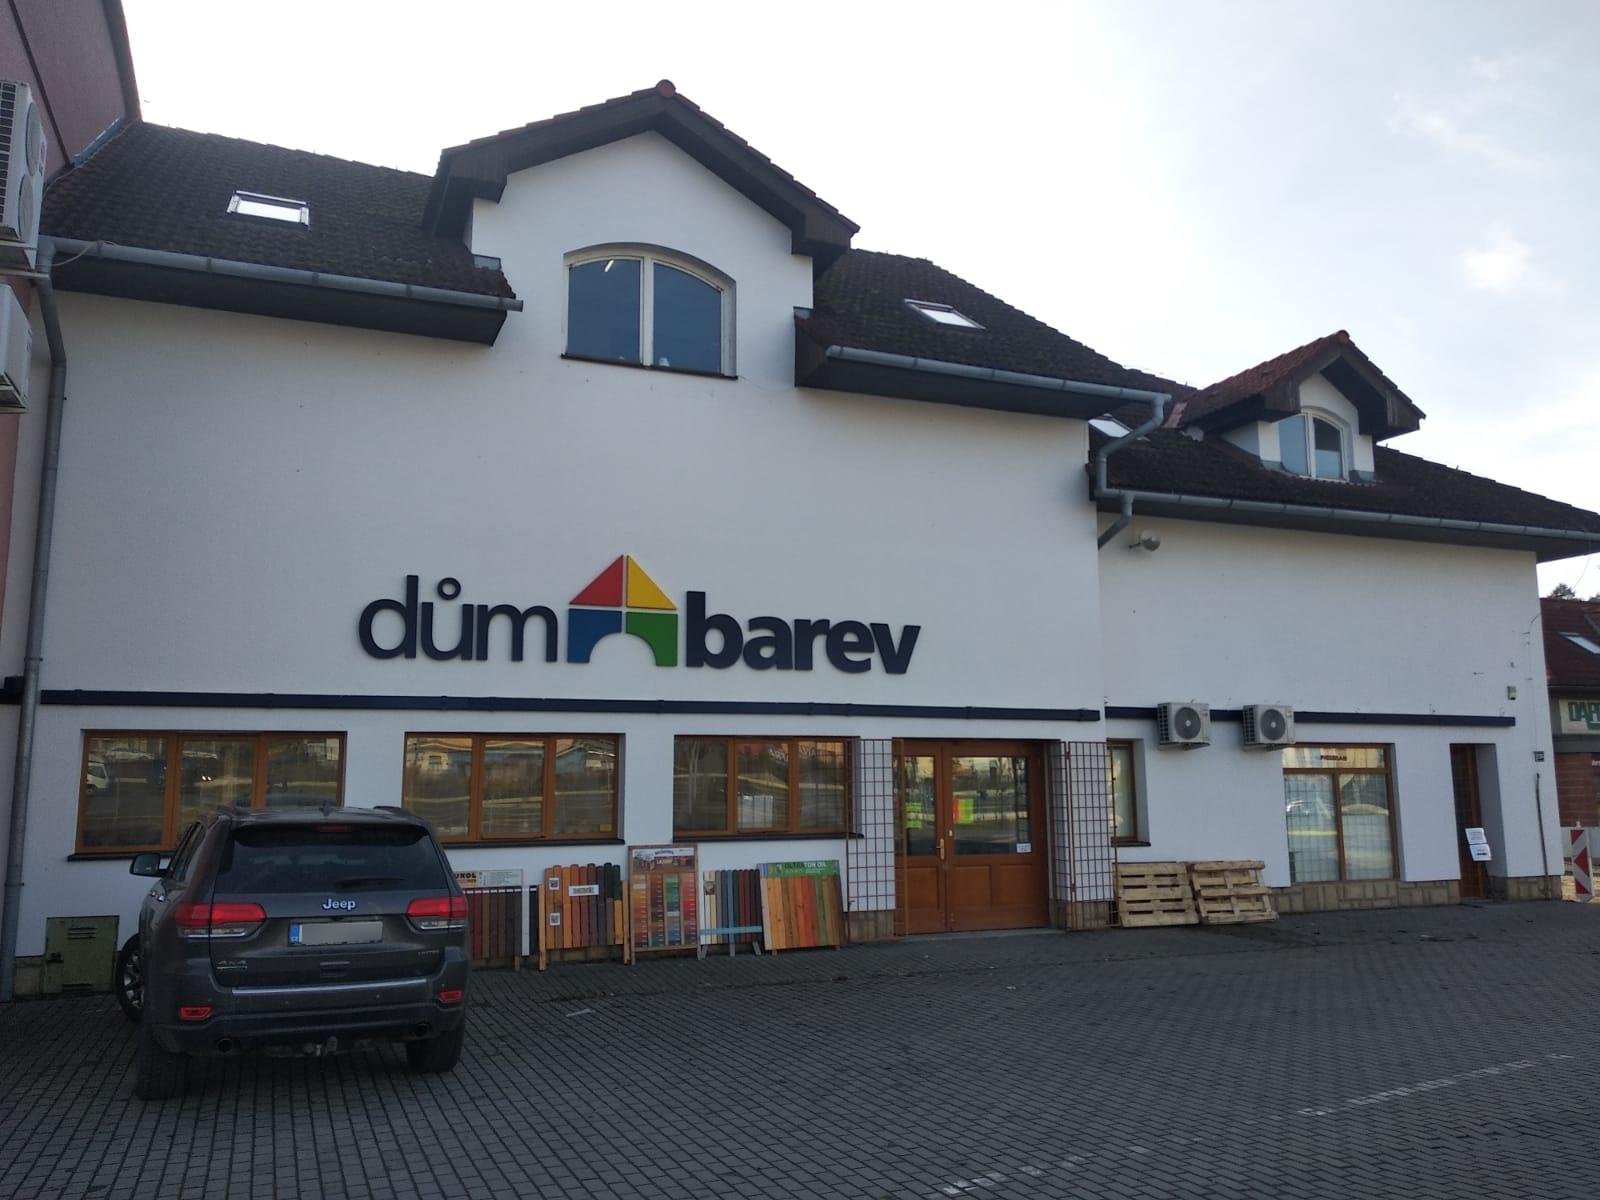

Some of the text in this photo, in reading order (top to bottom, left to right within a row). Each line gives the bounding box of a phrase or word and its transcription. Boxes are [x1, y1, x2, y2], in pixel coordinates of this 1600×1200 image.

[358, 574, 922, 675] dům barev
[455, 872, 477, 880] UXOL
[322, 898, 356, 911] Jeep
